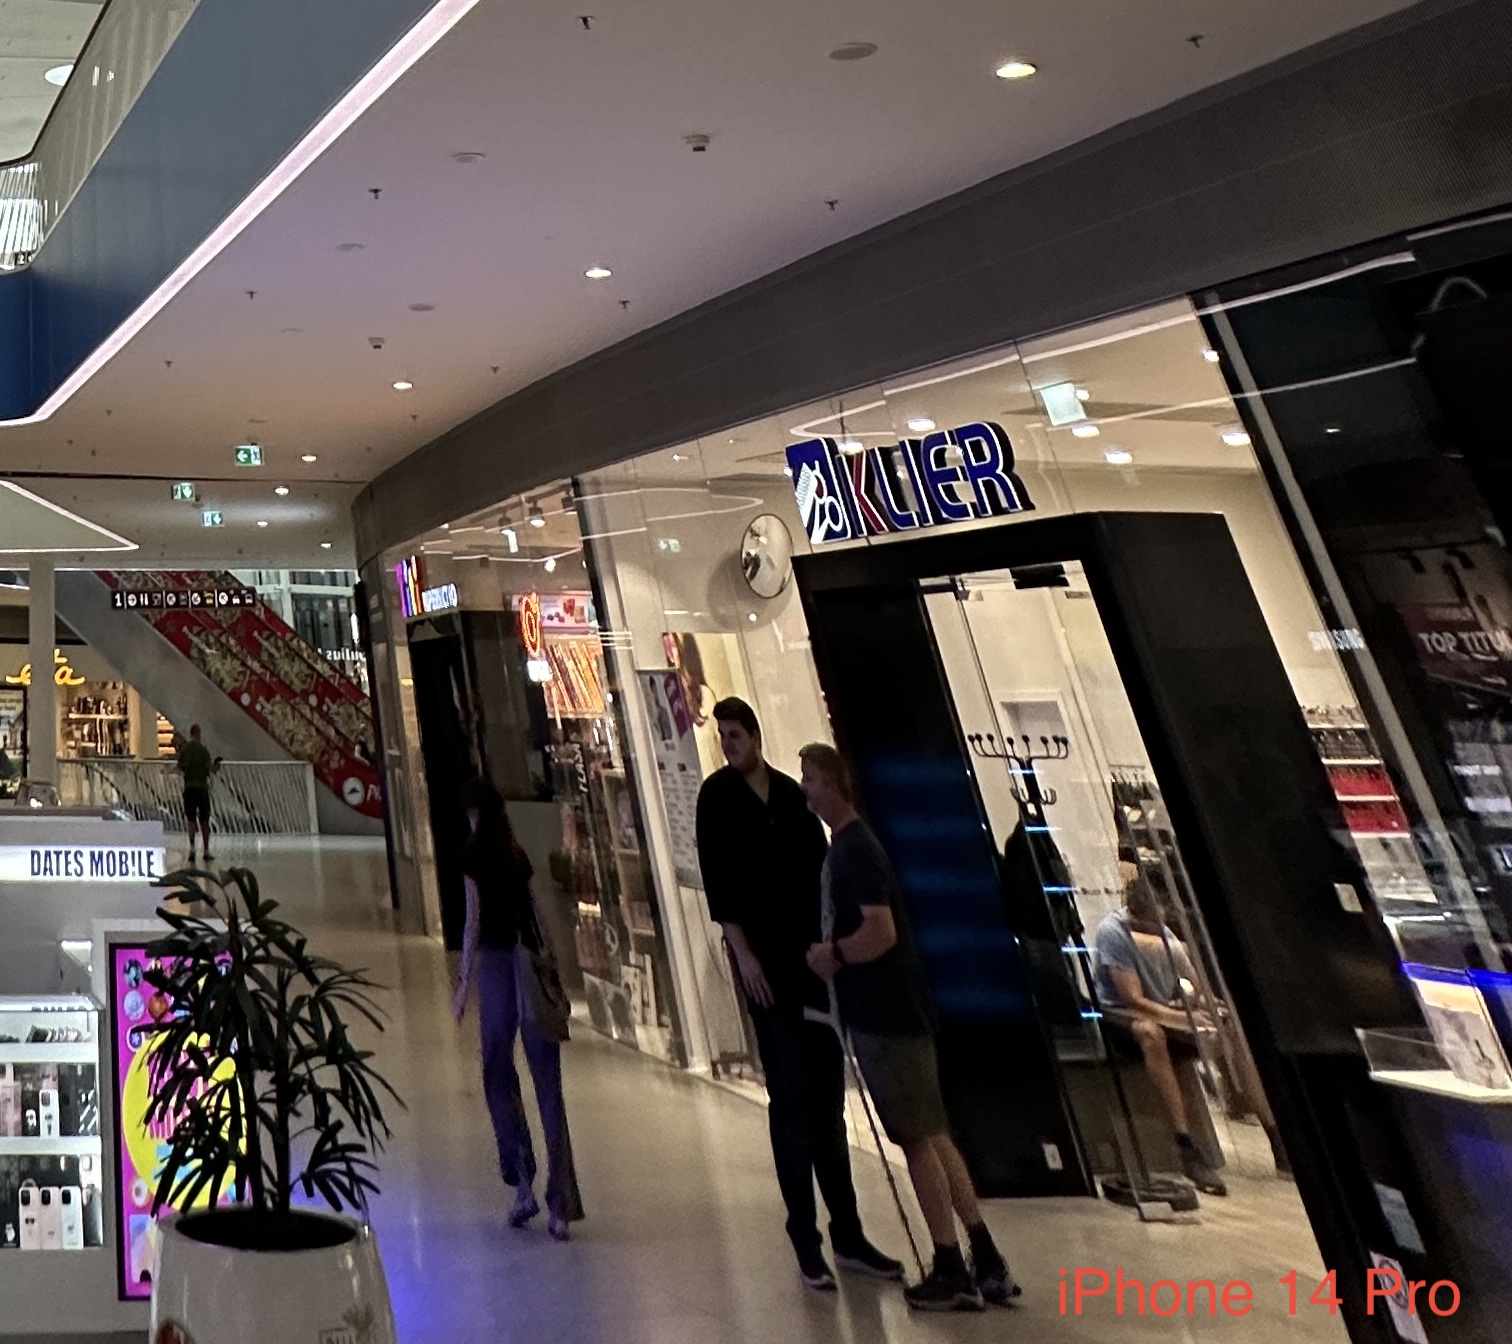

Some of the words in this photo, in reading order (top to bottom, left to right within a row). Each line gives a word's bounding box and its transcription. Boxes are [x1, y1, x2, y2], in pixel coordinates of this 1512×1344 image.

[834, 422, 1035, 538] KLIER
[115, 593, 122, 607] 1
[1418, 631, 1457, 653] TOP
[31, 850, 84, 877] DATES
